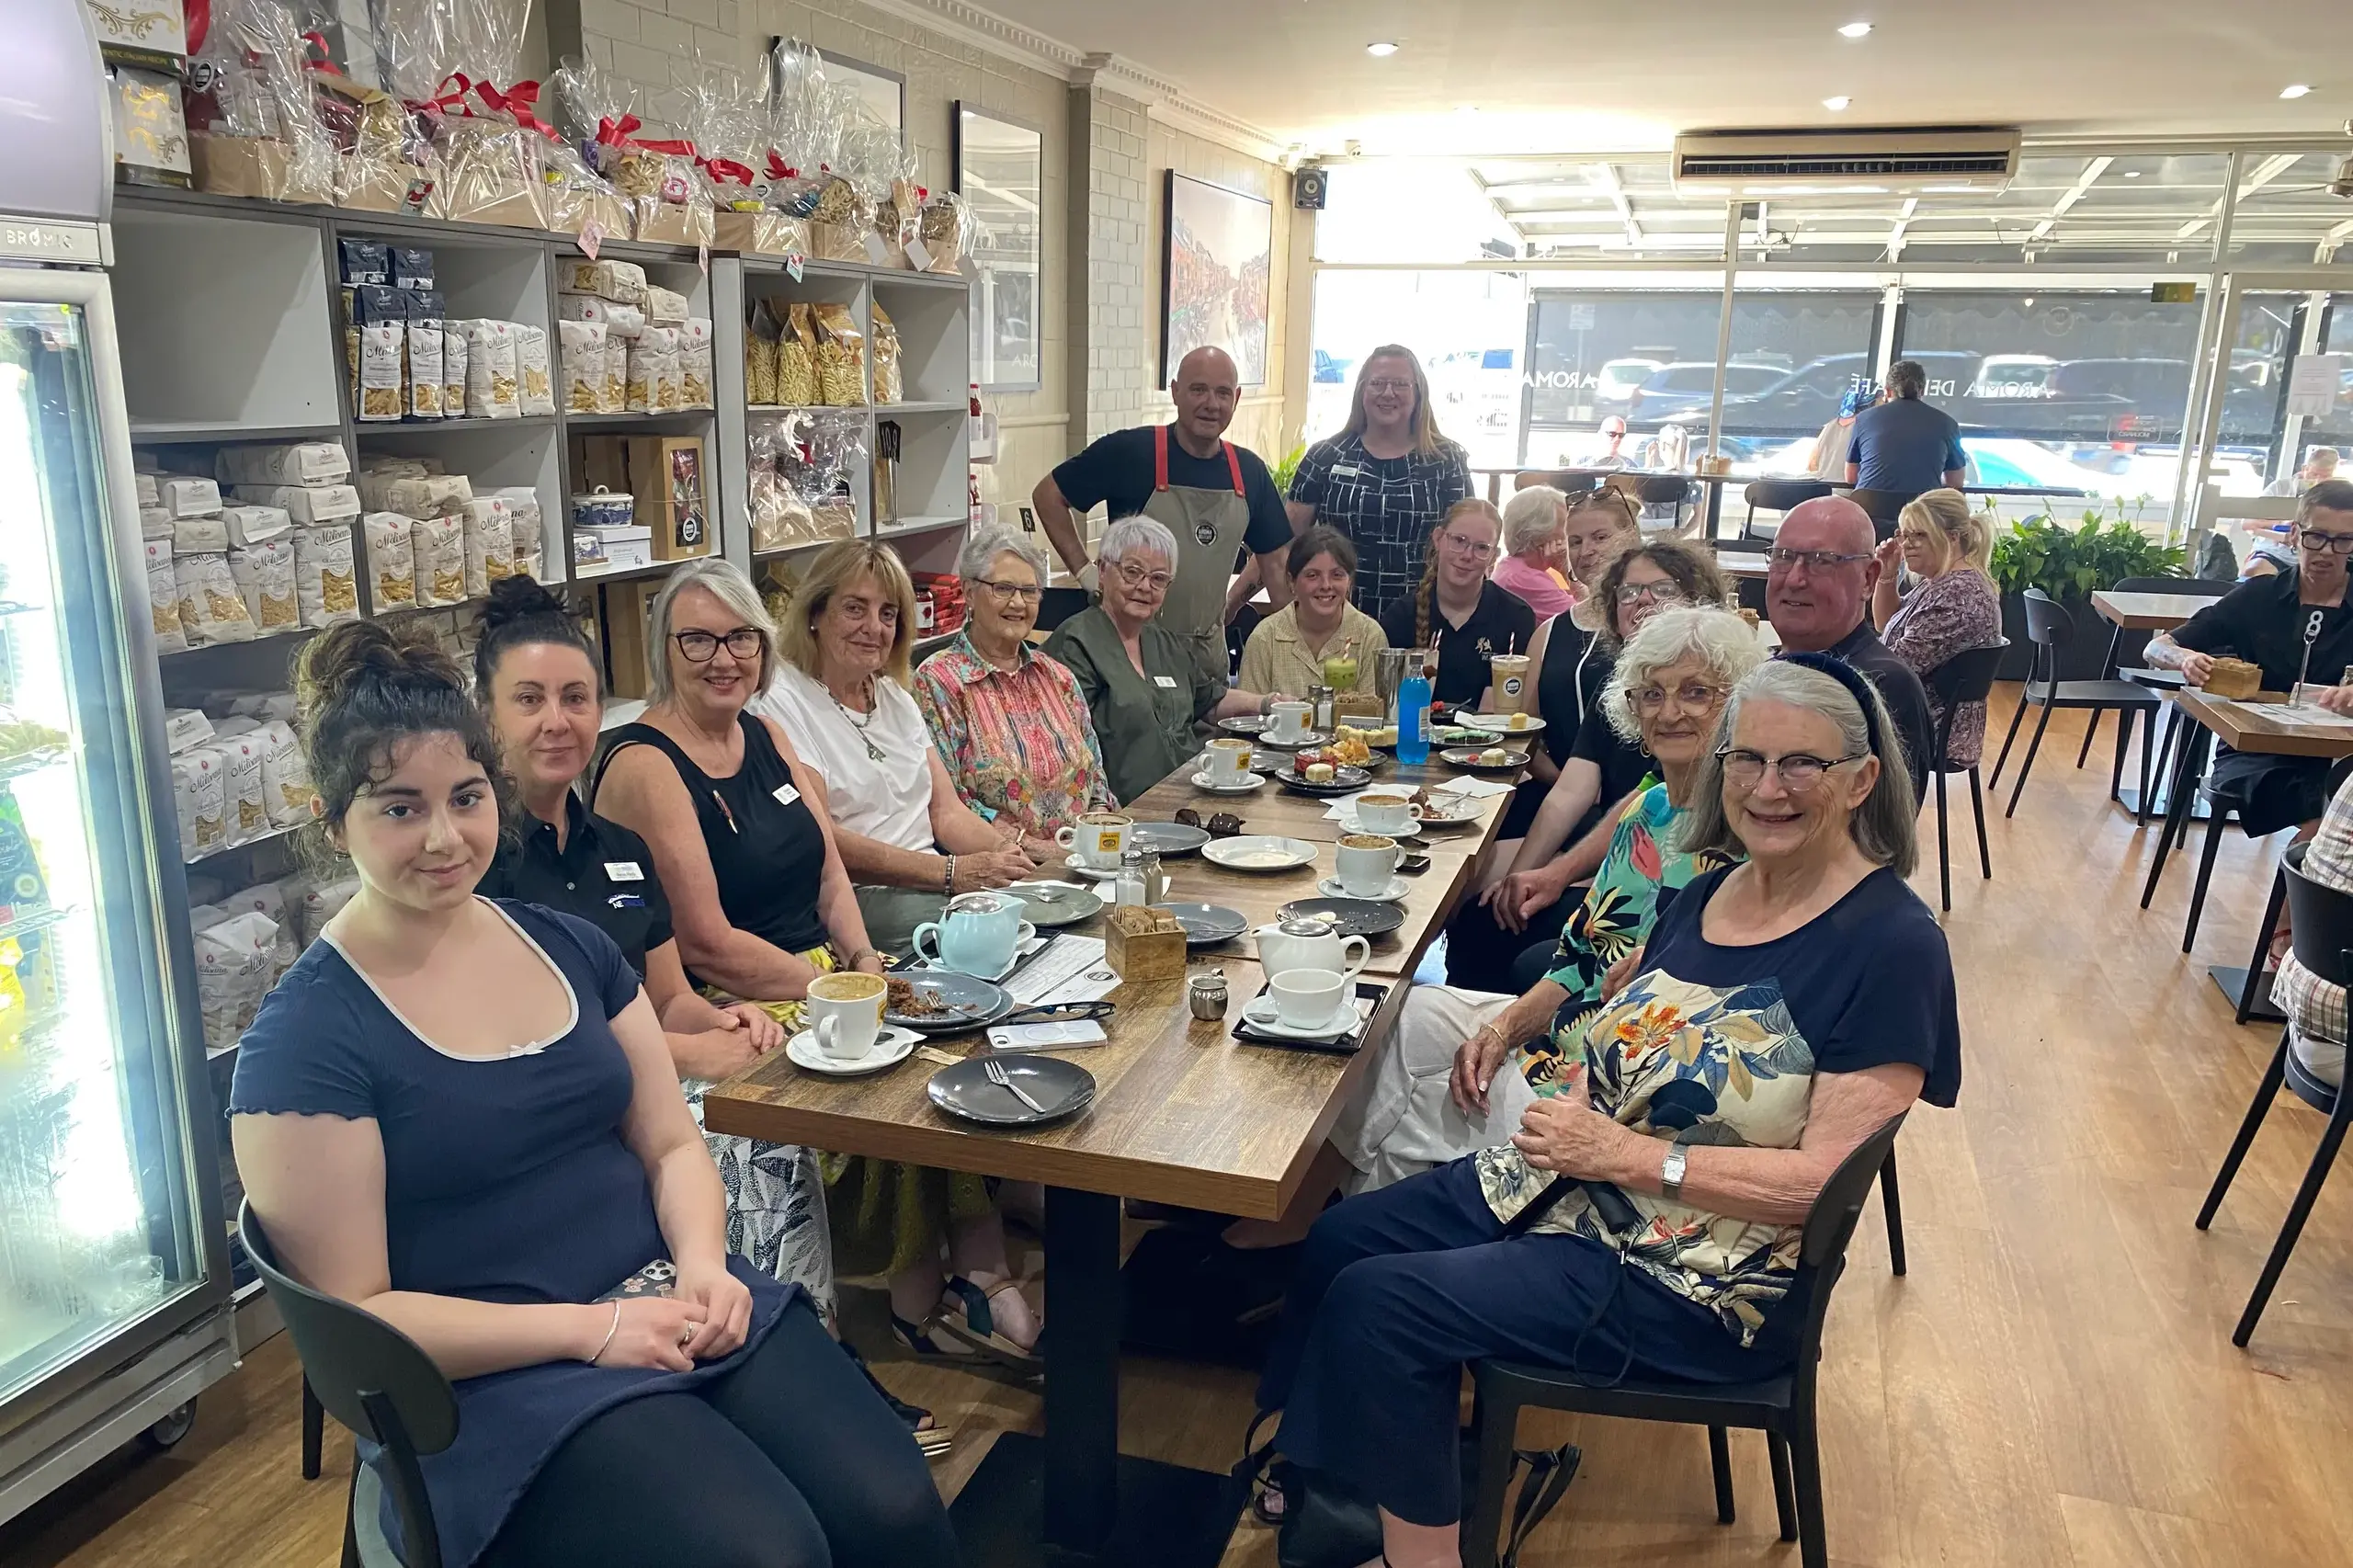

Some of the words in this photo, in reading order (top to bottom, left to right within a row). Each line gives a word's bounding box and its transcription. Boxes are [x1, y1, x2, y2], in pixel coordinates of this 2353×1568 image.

[1024, 511, 1032, 529] 6
[146, 556, 171, 574] olisana
[2306, 610, 2324, 636] 8
